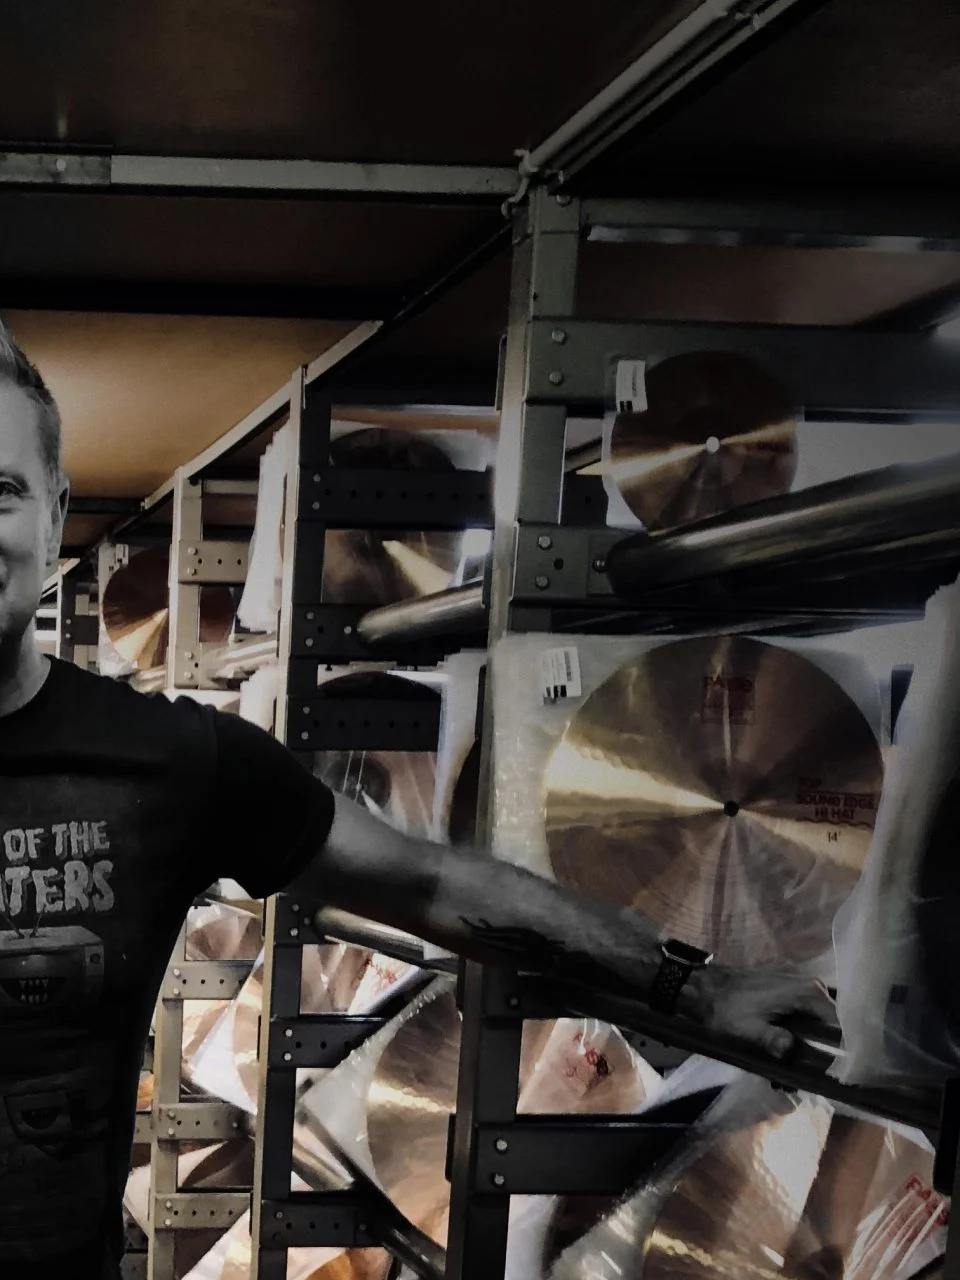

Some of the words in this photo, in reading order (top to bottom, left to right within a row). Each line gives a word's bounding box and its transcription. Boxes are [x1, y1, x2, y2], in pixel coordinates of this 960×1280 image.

[797, 793, 841, 807] SOUND
[2, 826, 44, 862] OF
[51, 820, 111, 857] THE
